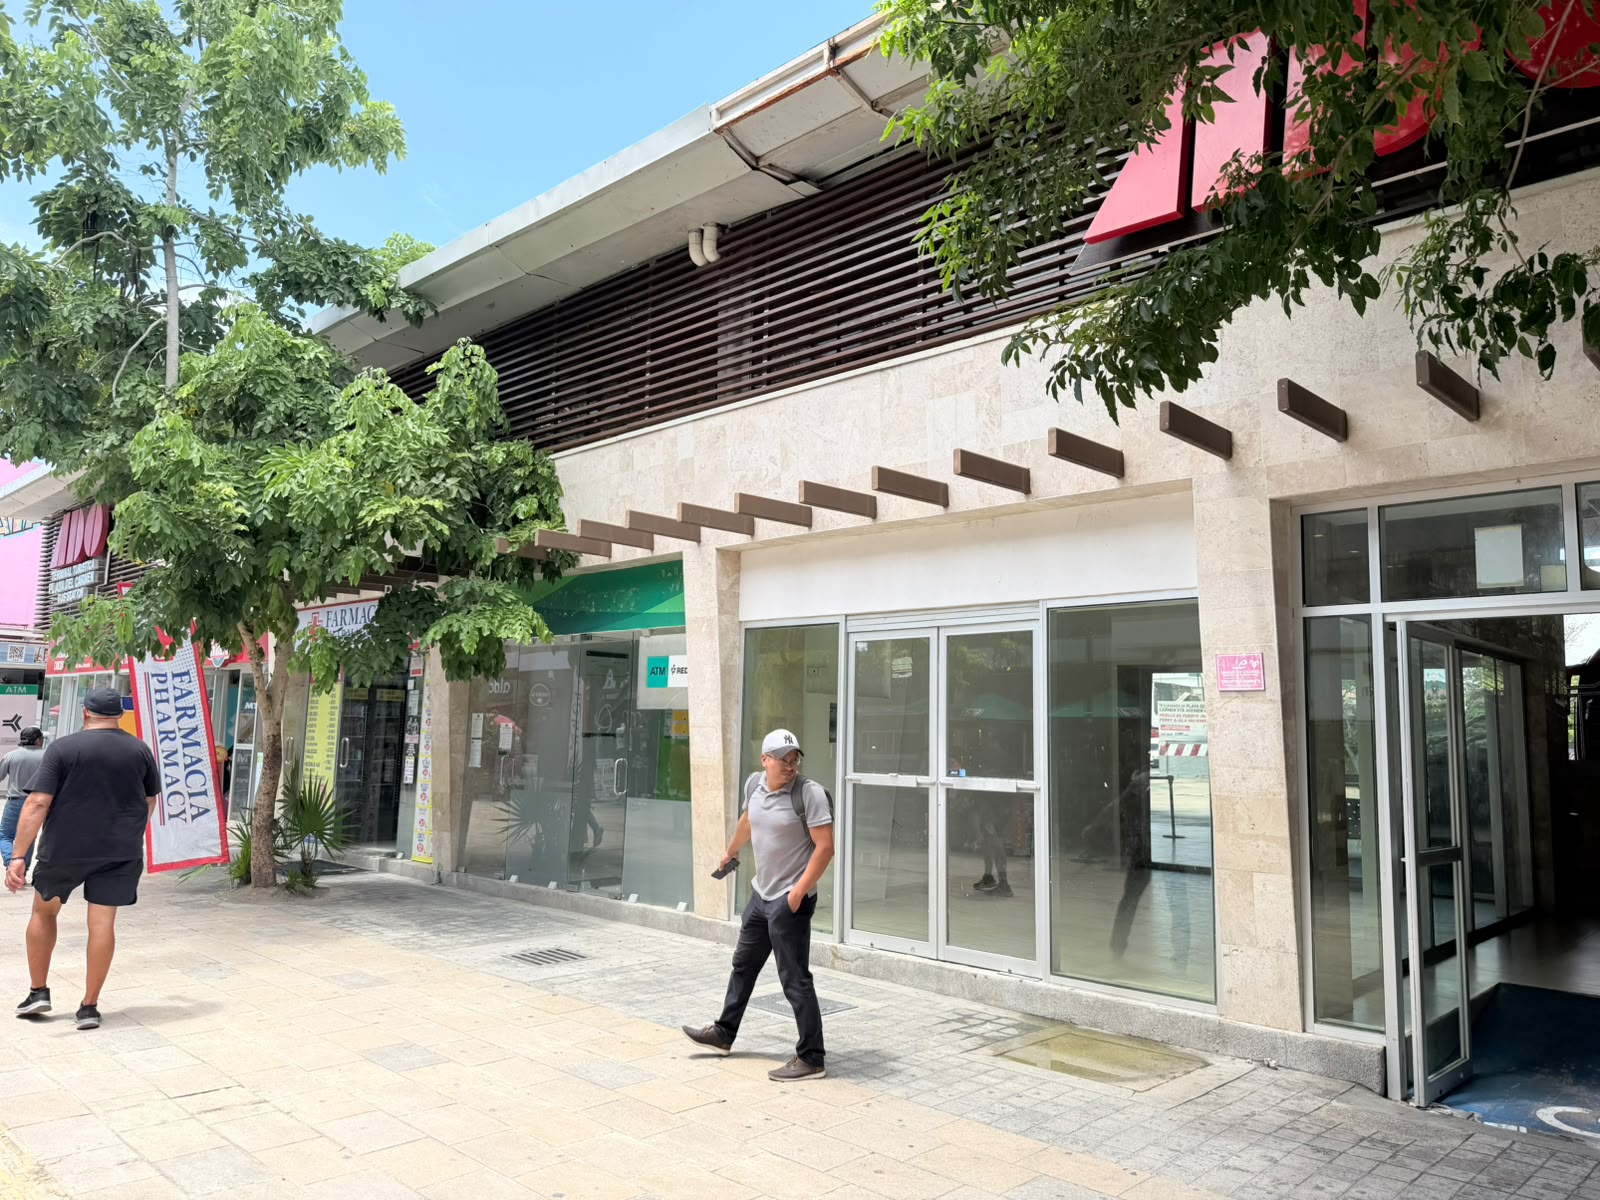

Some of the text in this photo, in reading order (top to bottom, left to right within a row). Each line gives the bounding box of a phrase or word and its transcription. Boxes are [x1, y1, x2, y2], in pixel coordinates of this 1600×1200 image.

[50, 503, 108, 570] ADO
[326, 604, 378, 628] FARMAC
[6, 686, 27, 694] ATM
[650, 666, 666, 676] ATM
[151, 672, 188, 823] PHARMACY
[172, 670, 211, 823] FARMACIA
